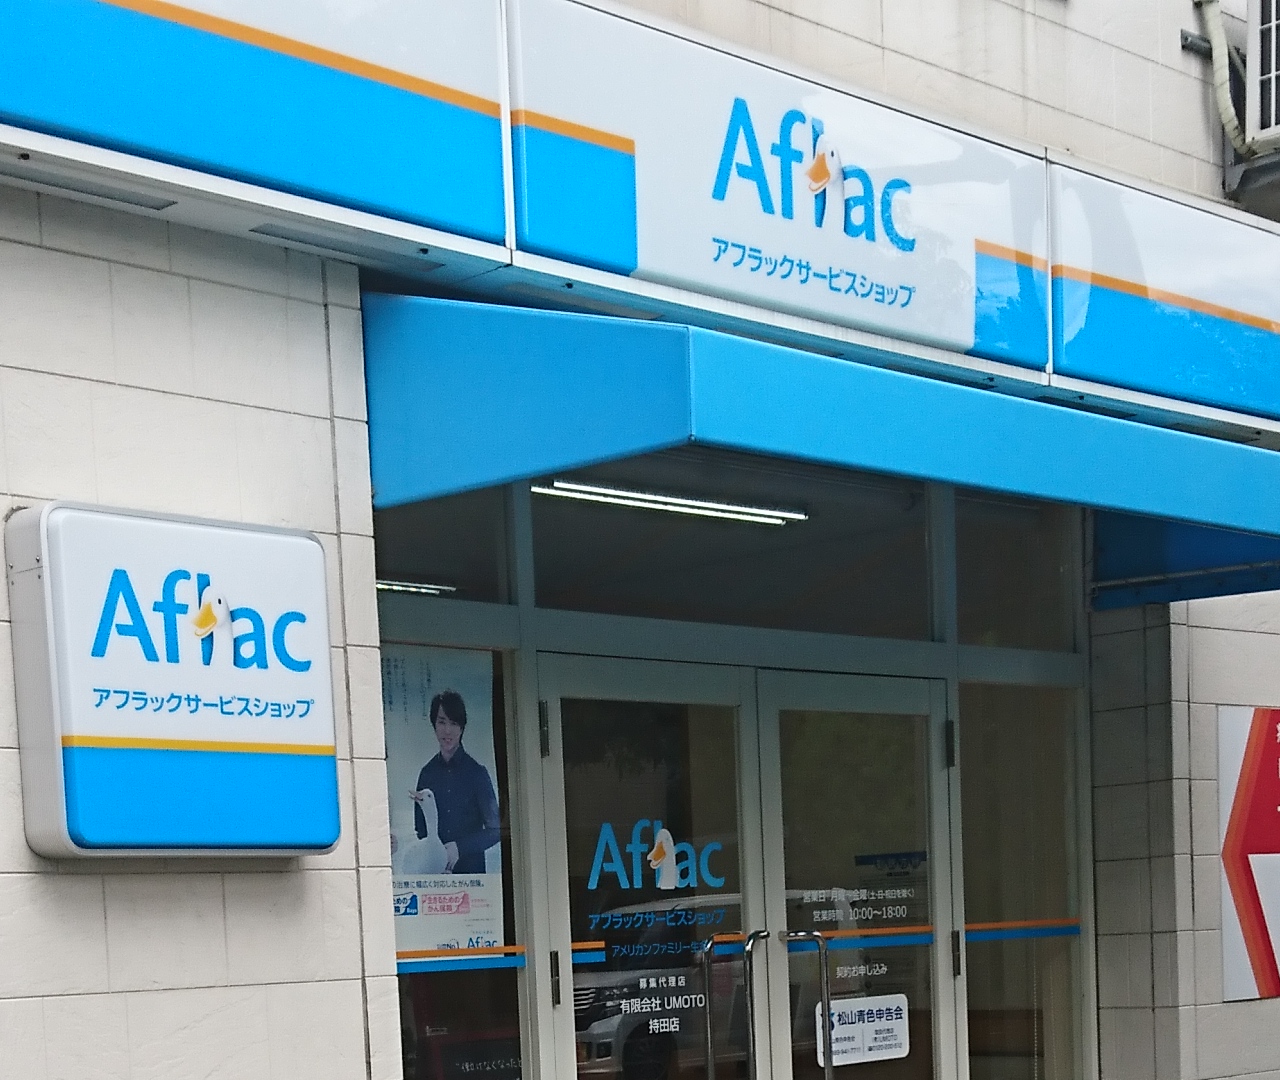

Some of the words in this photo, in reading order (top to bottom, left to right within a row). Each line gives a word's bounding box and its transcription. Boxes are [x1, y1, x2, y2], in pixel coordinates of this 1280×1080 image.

[711, 97, 916, 252] Aflac
[712, 237, 917, 309] アフラックサービスショップ
[92, 687, 315, 720] アフラックサービスショップ
[588, 908, 728, 930] アフラックサービスショップ
[639, 975, 686, 989] 募集代理店
[620, 996, 662, 1014] 有限会社
[664, 994, 705, 1010] UMOTO
[837, 1004, 904, 1026] 松山青色申告会
[649, 1017, 680, 1034] 持田店
